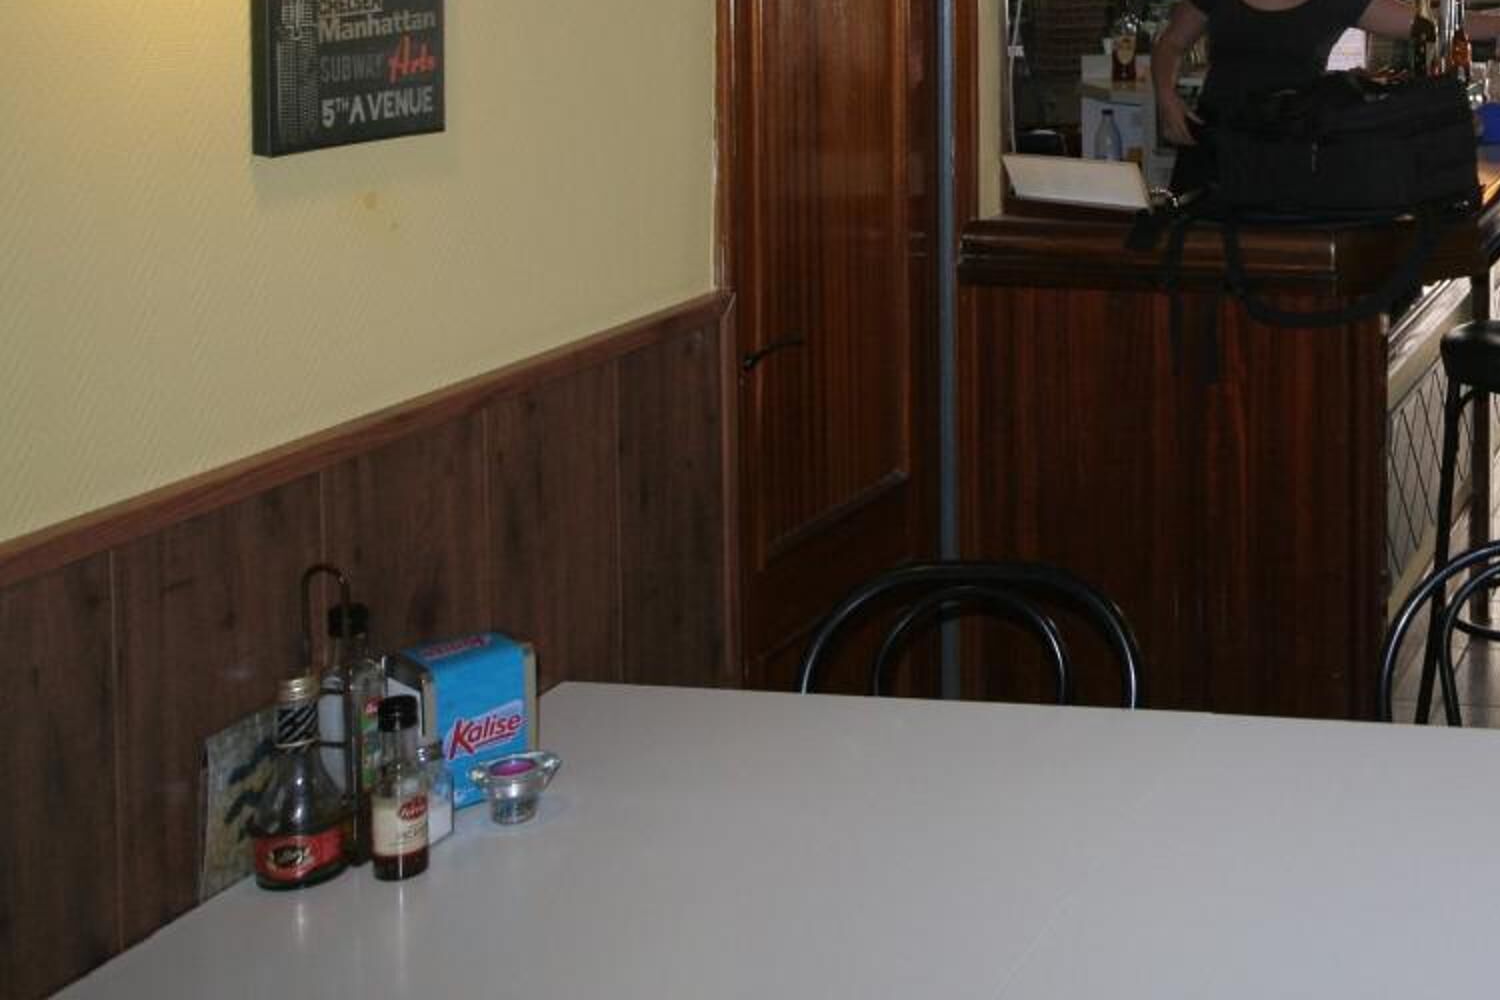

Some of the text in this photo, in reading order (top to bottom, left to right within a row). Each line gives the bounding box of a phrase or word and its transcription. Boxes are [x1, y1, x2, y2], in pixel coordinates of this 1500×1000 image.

[321, 10, 436, 43] Manhattan
[349, 85, 433, 125] AVENUE
[449, 714, 522, 760] Kalise
